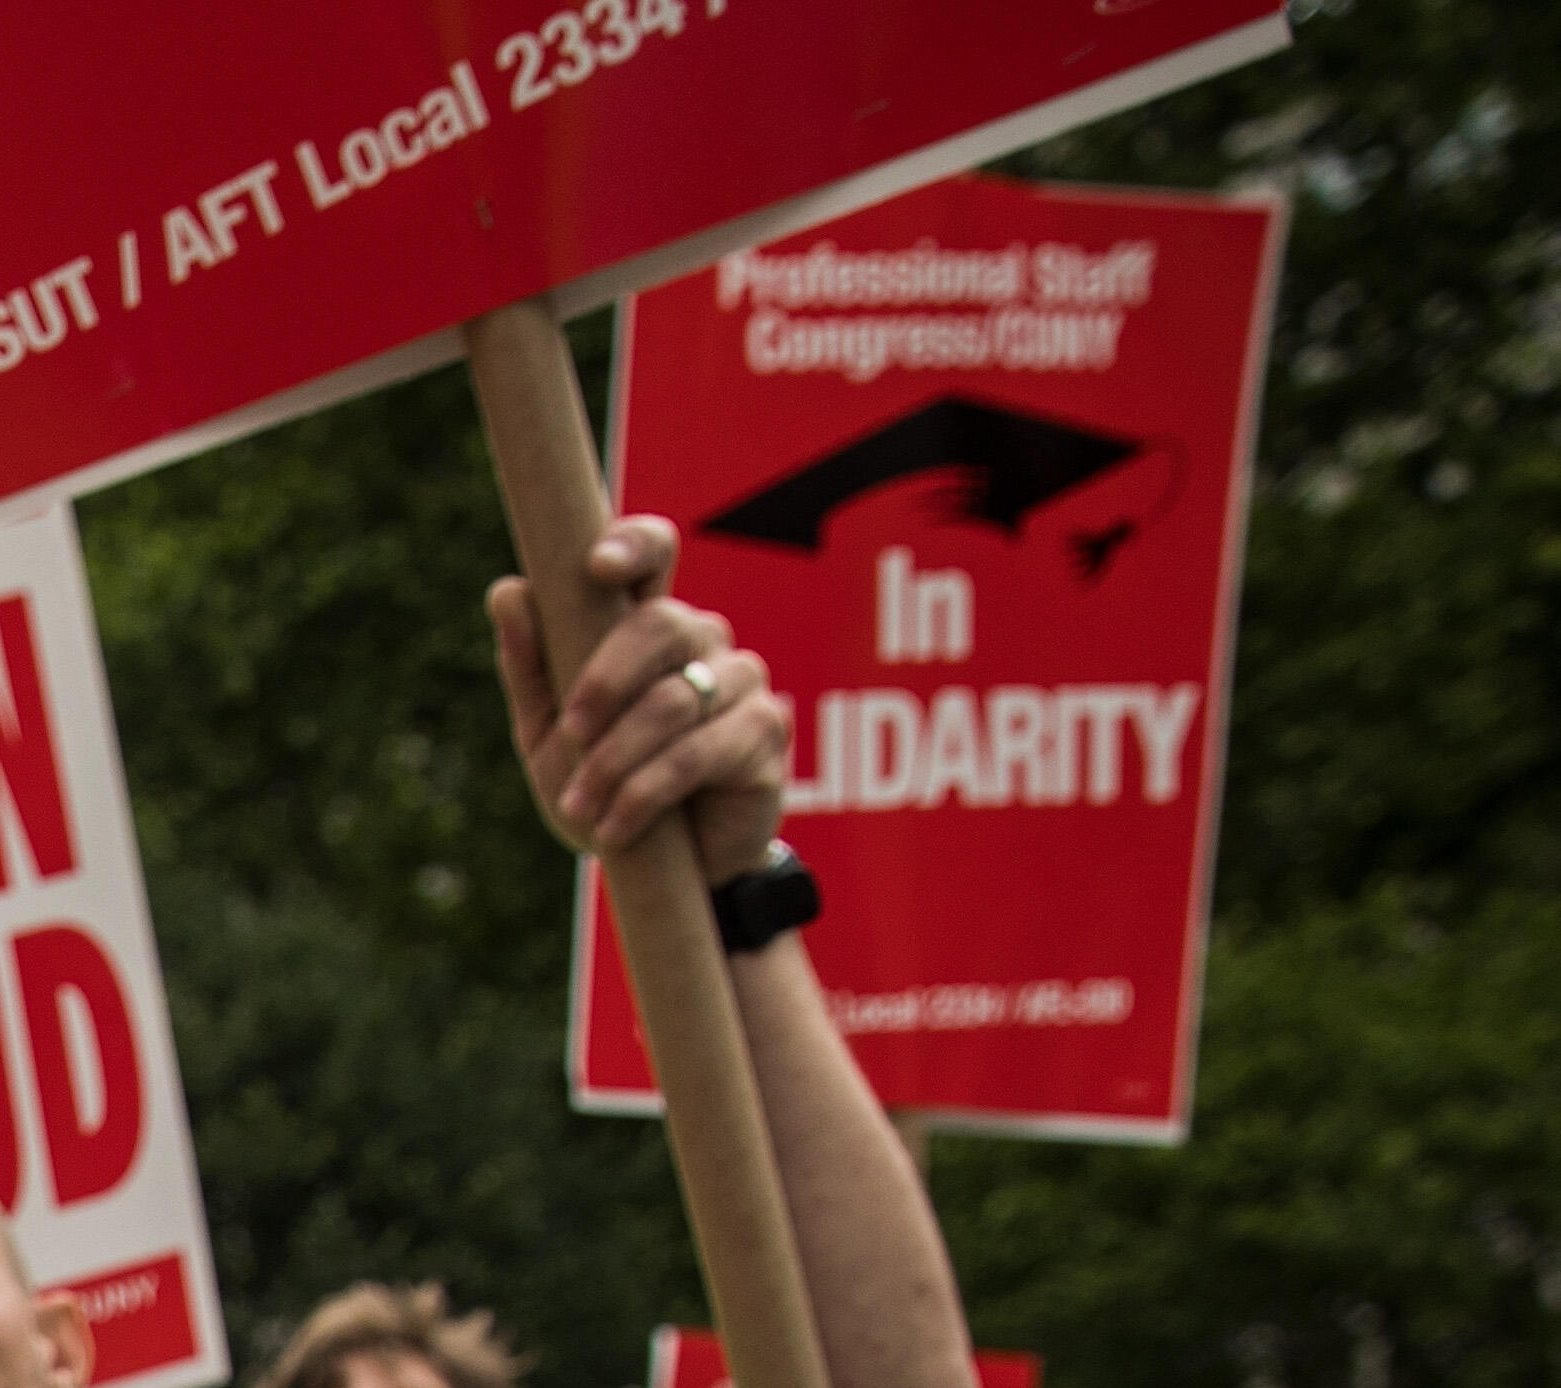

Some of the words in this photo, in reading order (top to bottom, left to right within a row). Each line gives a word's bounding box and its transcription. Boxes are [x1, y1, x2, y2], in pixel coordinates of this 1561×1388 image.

[162, 160, 285, 286] AFT
[294, 58, 490, 211] Local
[494, 0, 687, 112] 2334
[1032, 240, 1156, 307] Staff
[876, 545, 975, 665] In
